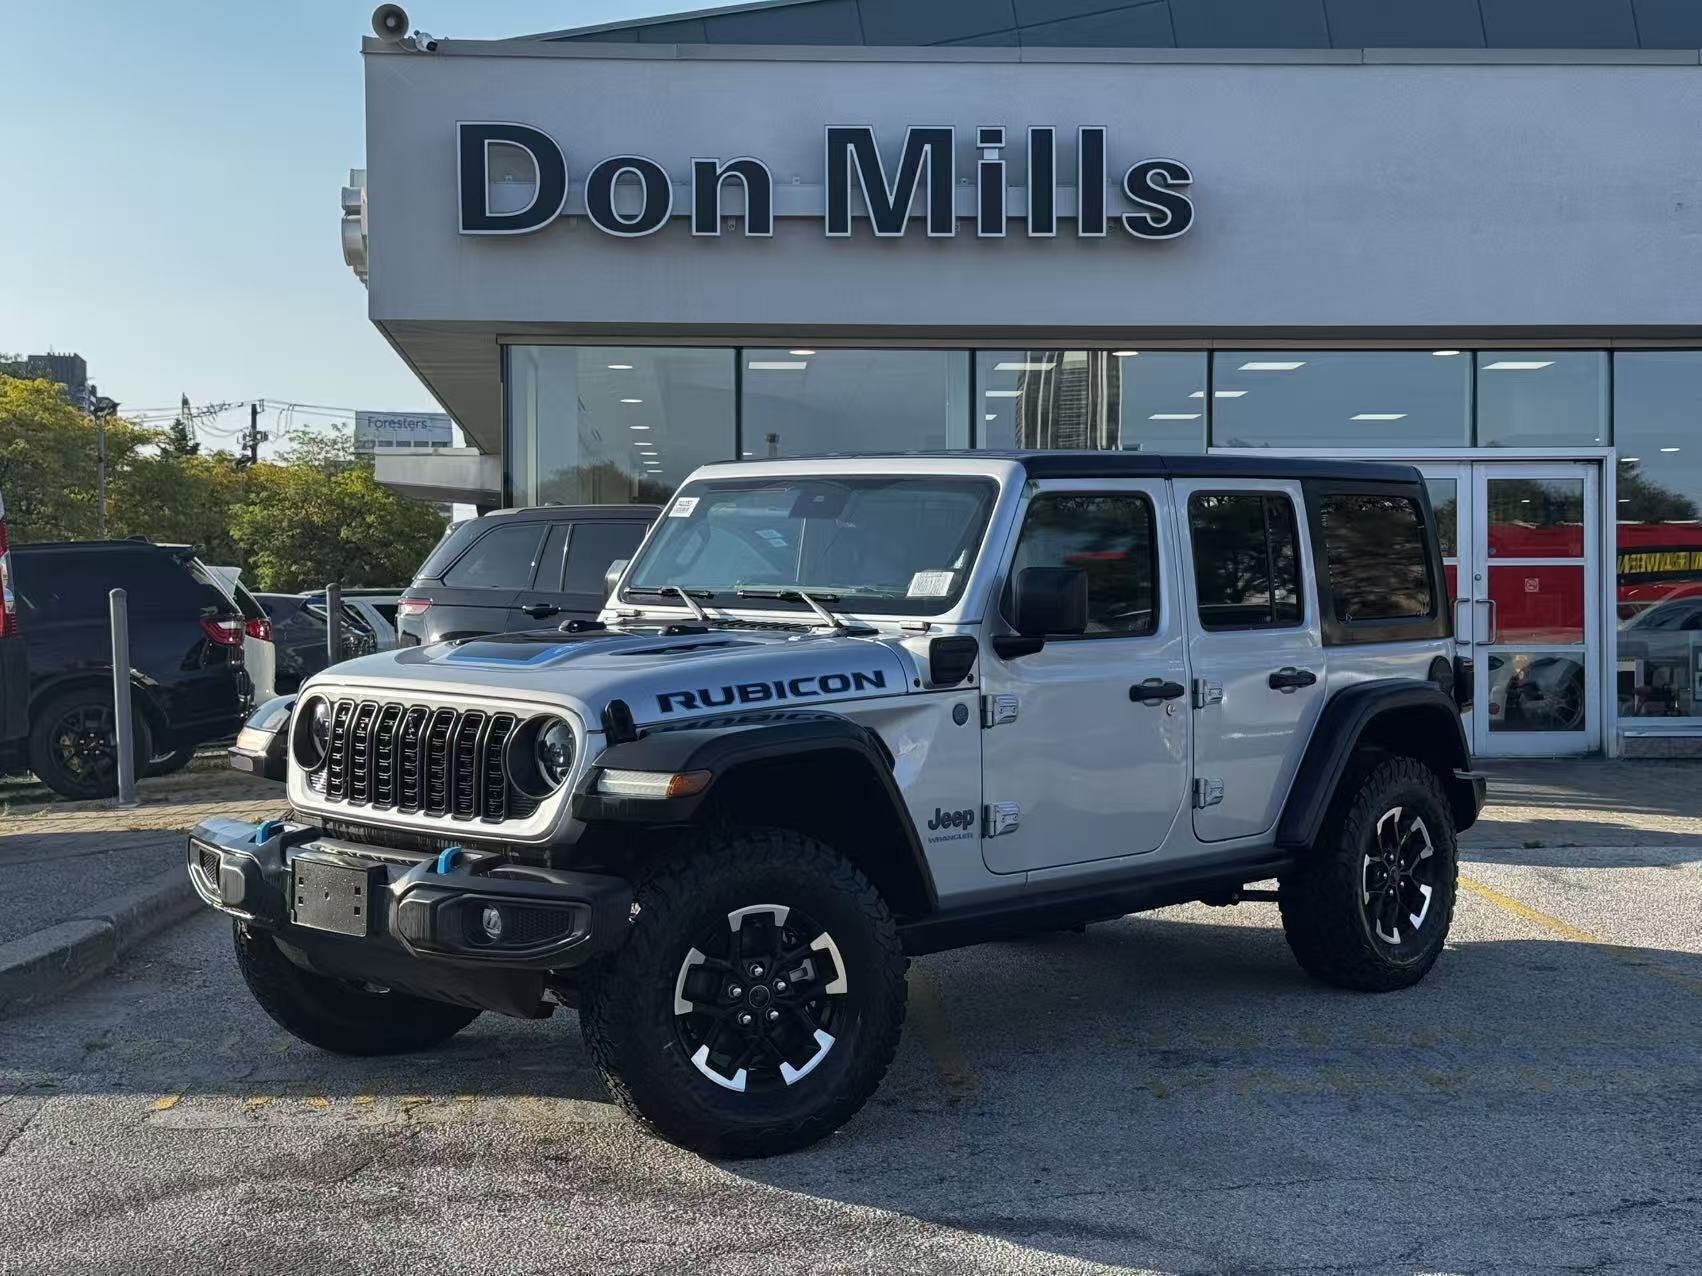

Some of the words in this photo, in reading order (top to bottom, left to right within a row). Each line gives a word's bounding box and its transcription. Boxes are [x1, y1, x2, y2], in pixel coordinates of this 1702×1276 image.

[455, 120, 773, 237] Don
[824, 124, 1194, 239] Mills
[366, 416, 429, 430] Foresters
[656, 669, 887, 713] RUBICON
[927, 807, 975, 830] Jeep
[927, 833, 974, 844] WRANGLER
